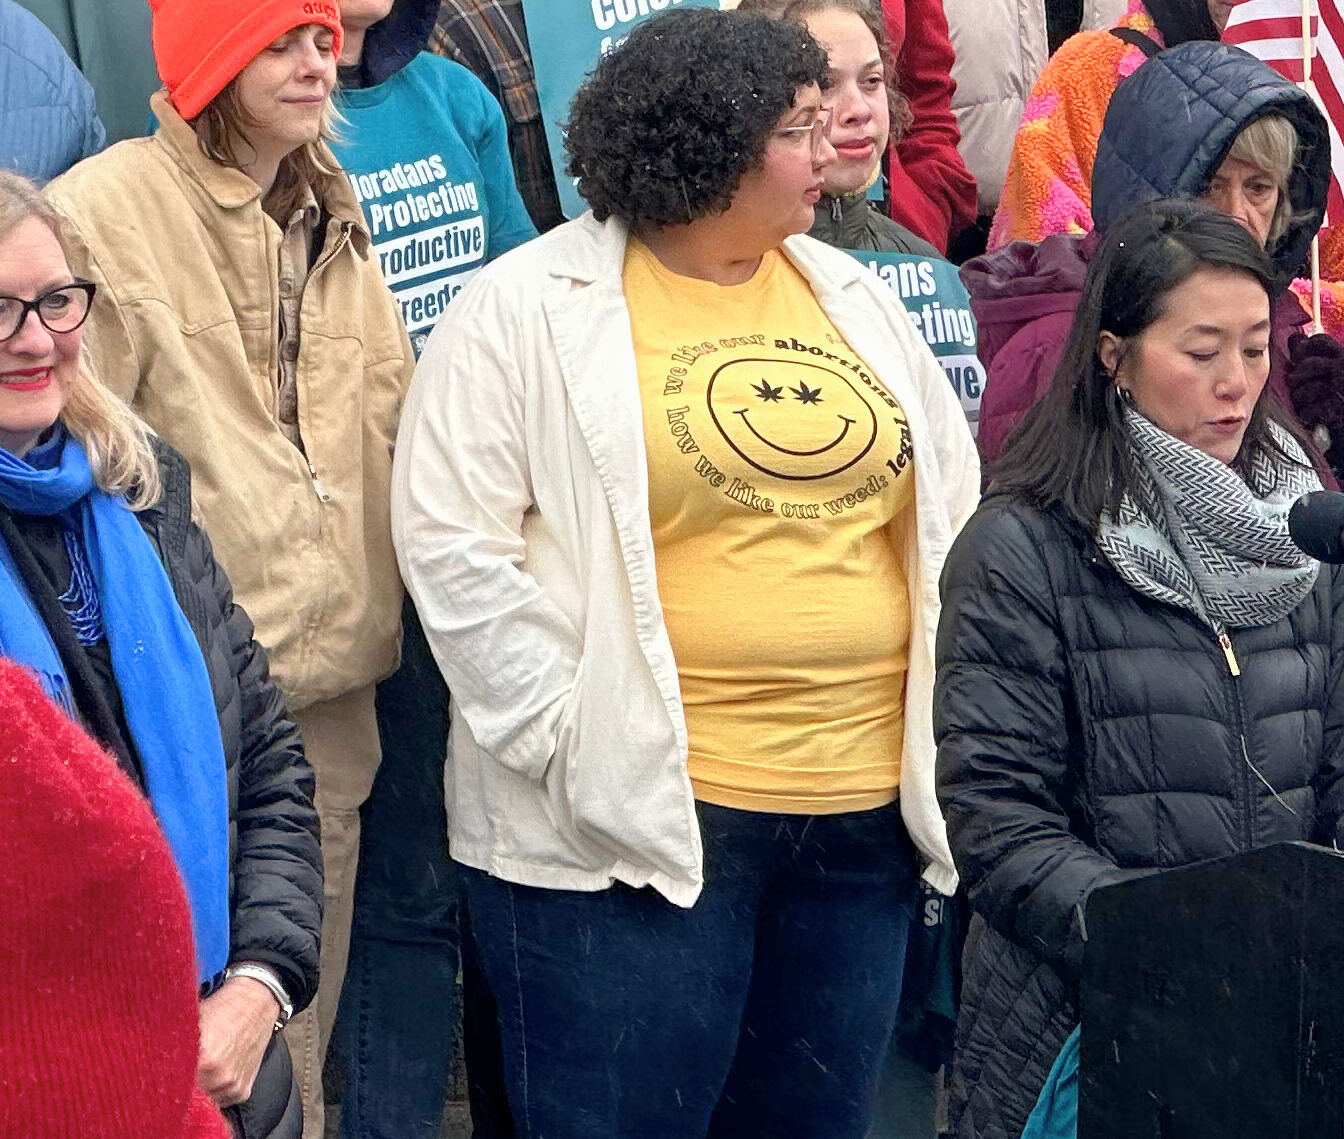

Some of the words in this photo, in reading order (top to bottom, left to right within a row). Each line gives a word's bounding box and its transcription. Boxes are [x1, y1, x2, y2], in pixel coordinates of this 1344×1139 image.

[369, 182, 479, 236] Protecting
[672, 341, 718, 366] like
[719, 333, 766, 348] our
[663, 365, 687, 396] we
[774, 338, 898, 409] abortions
[666, 405, 700, 456] how
[694, 454, 726, 488] we
[724, 477, 775, 513] like
[780, 502, 821, 519] our
[823, 474, 889, 517] weed:
